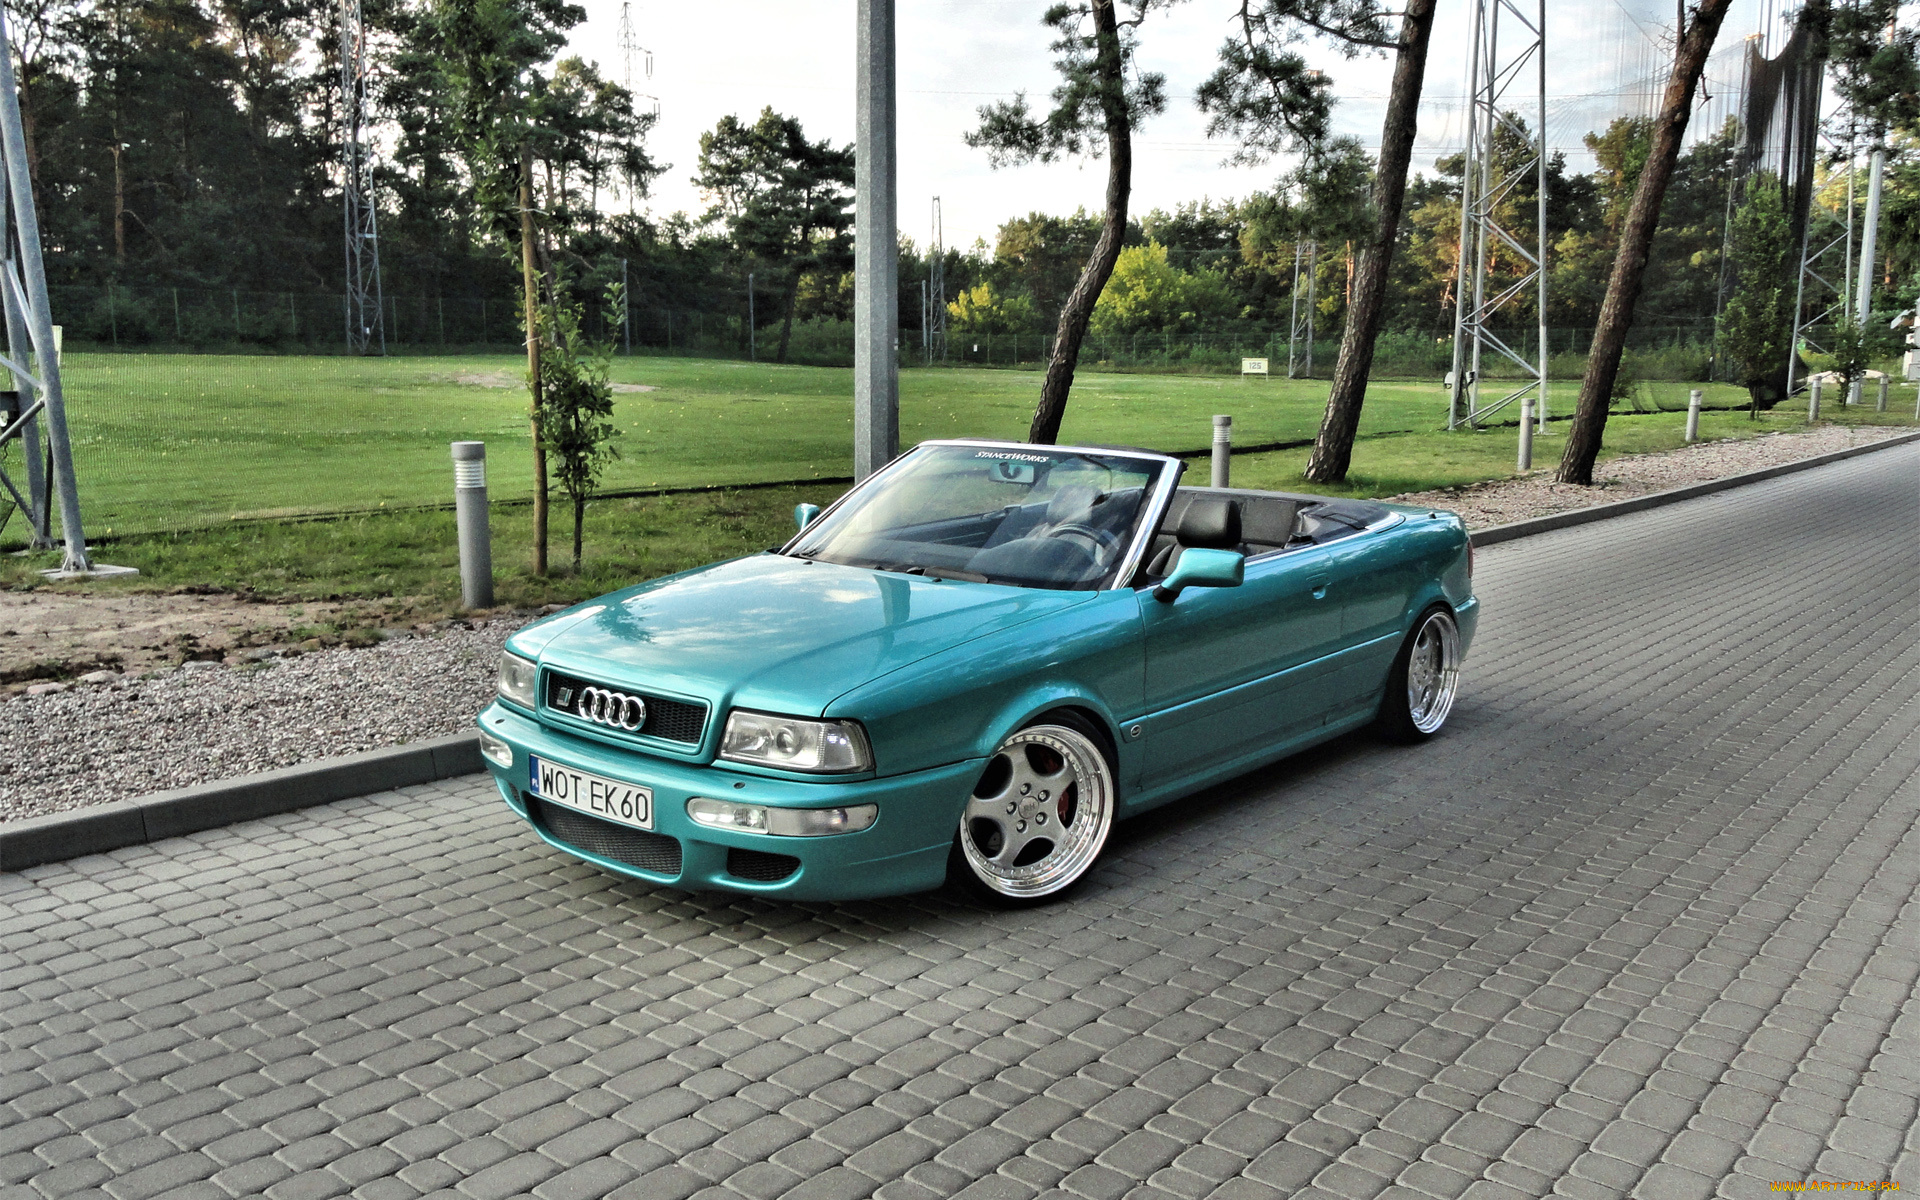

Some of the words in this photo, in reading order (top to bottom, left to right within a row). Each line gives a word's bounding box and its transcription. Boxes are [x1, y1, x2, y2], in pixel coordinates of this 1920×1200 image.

[1249, 362, 1262, 370] 125
[532, 778, 539, 788] PL
[541, 764, 582, 804] WOT
[590, 780, 648, 823] EK60
